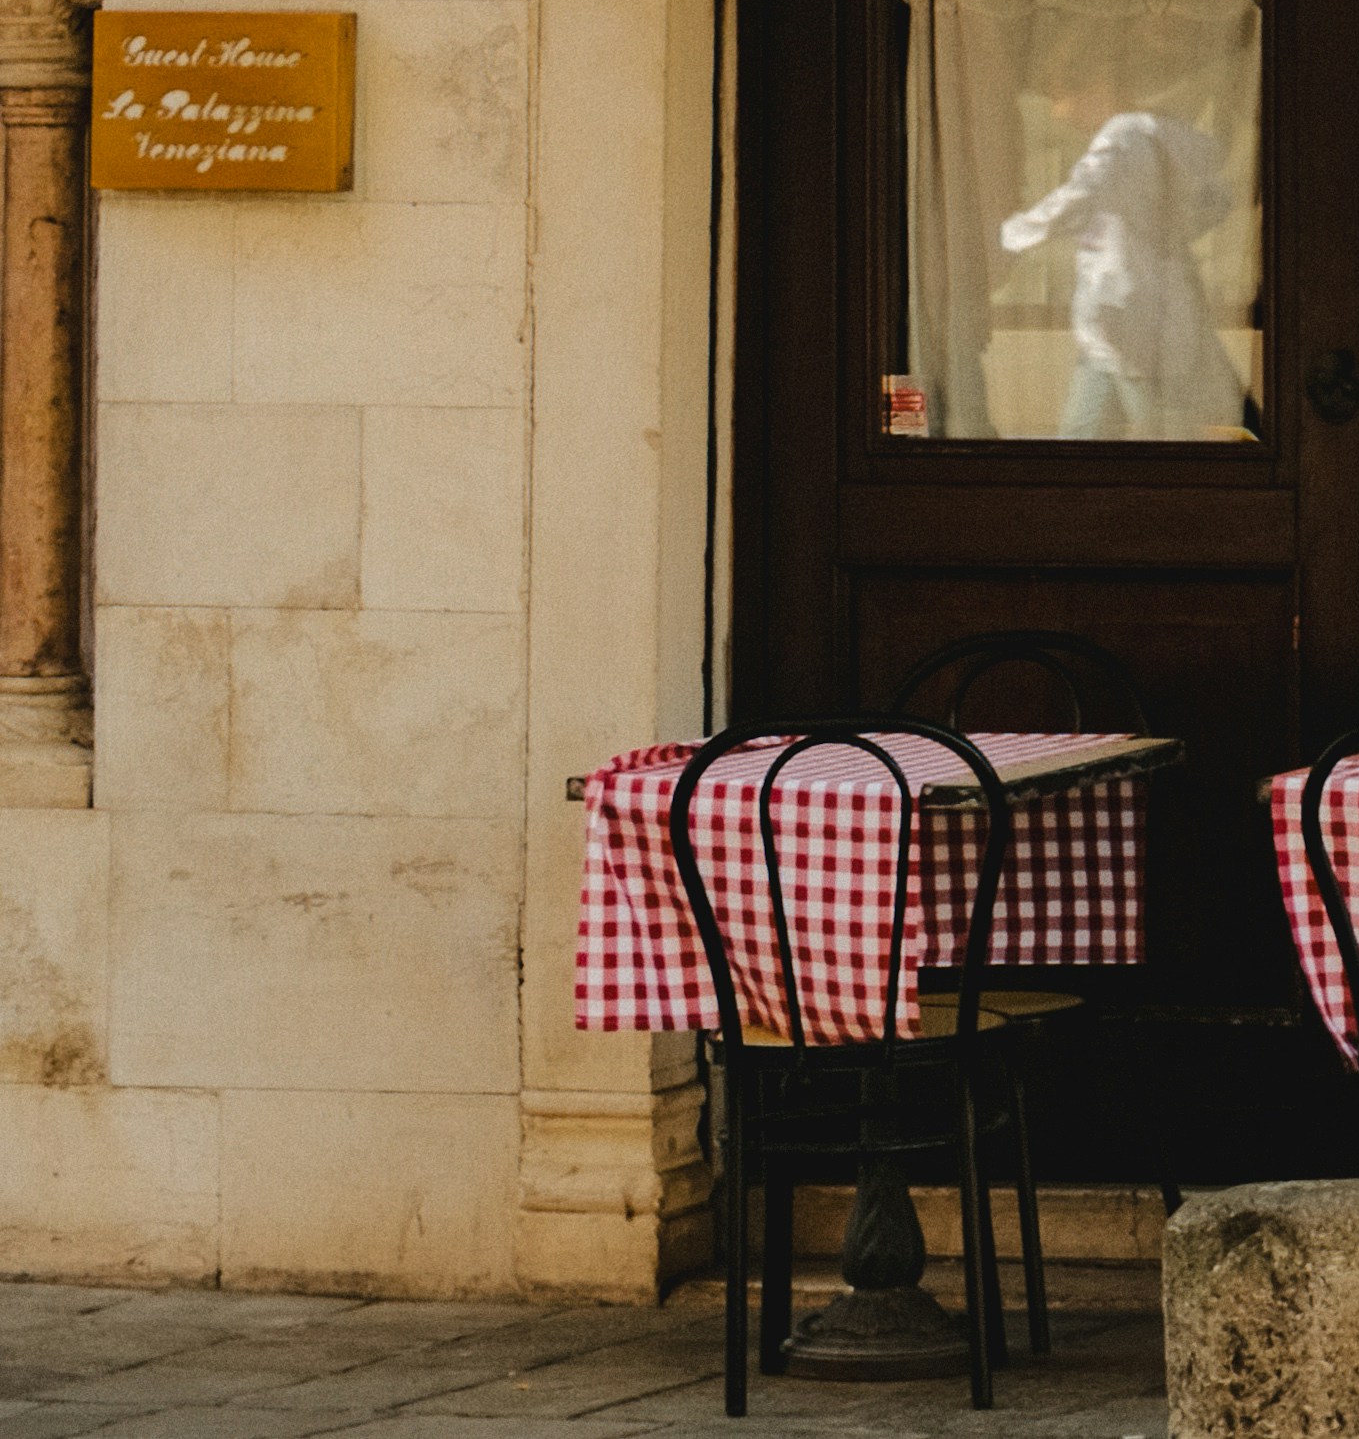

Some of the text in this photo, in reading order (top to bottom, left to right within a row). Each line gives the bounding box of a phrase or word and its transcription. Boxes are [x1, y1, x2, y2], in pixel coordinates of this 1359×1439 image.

[123, 35, 302, 68] Guest House
[102, 89, 318, 134] La Palazzina
[135, 131, 289, 174] Veneziana
